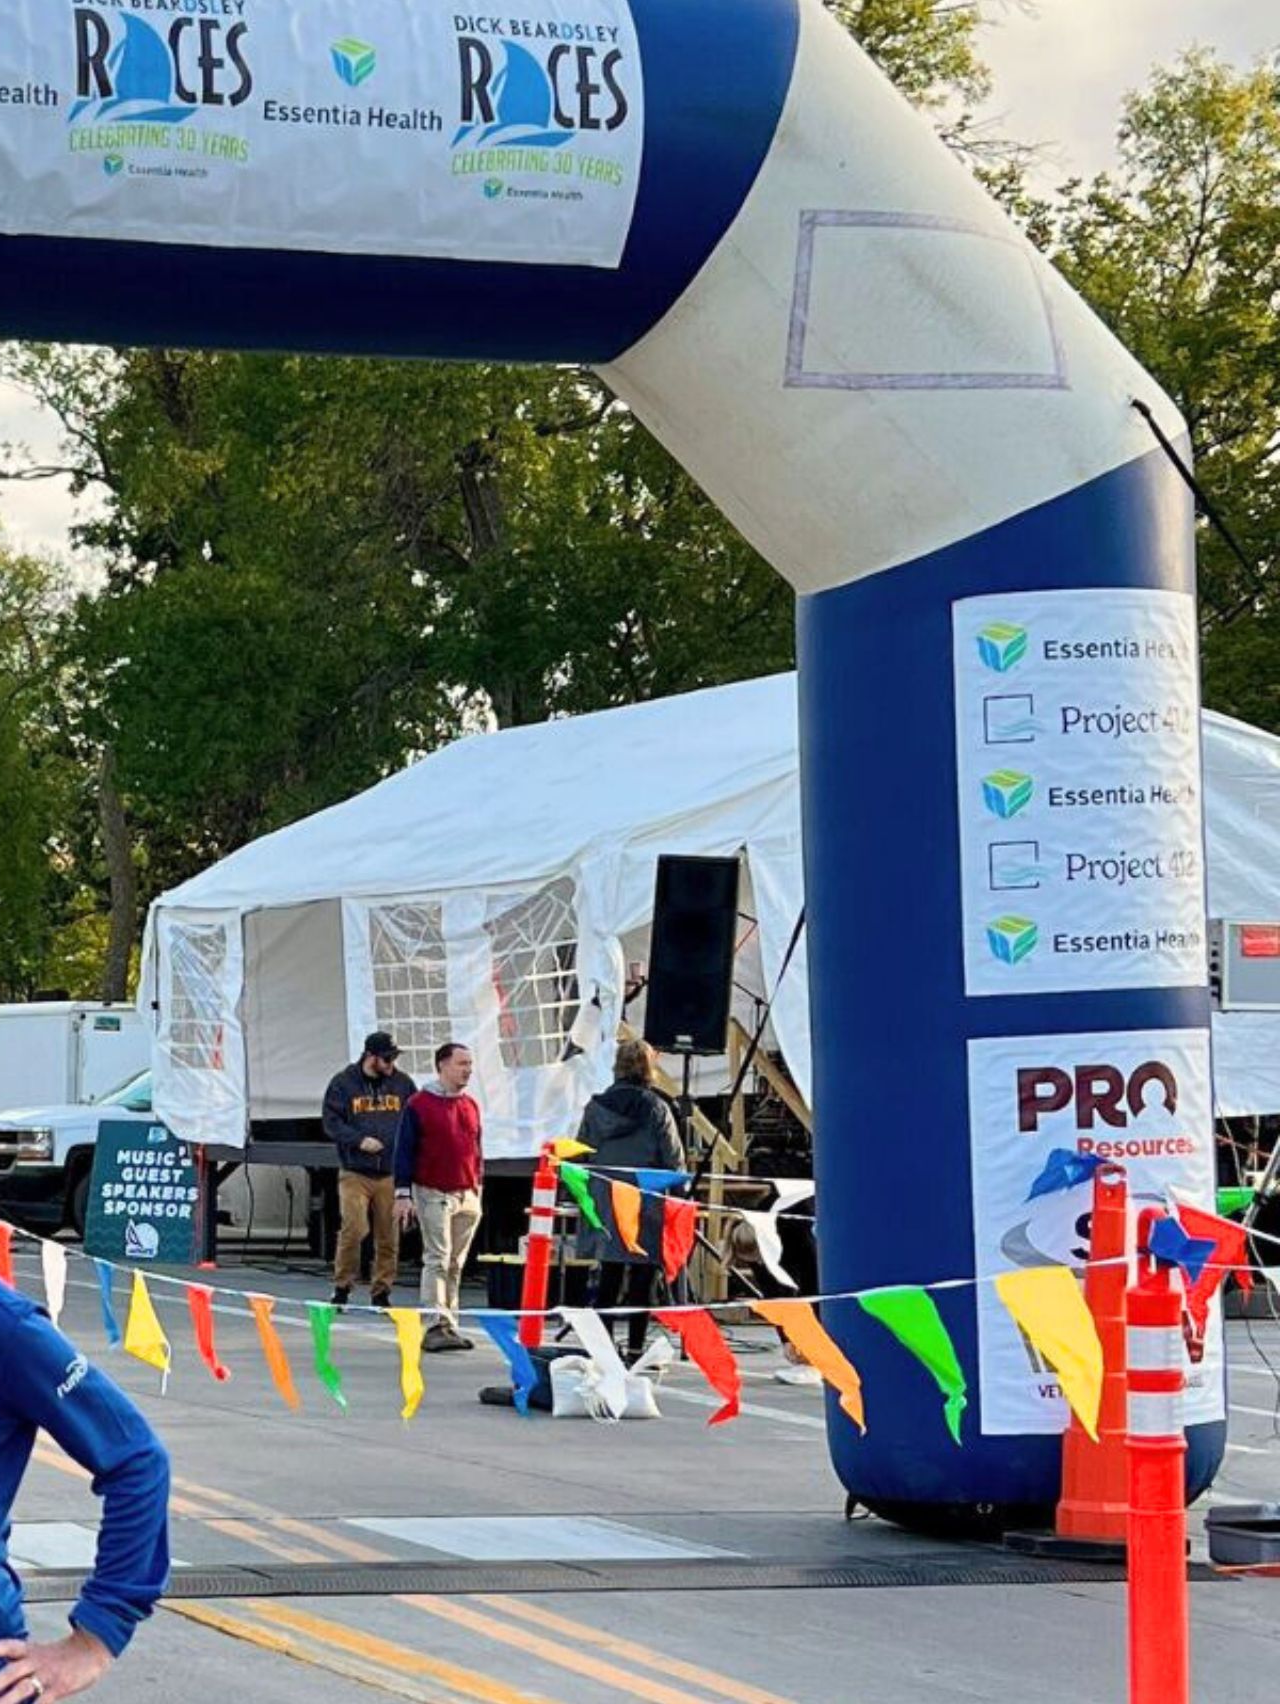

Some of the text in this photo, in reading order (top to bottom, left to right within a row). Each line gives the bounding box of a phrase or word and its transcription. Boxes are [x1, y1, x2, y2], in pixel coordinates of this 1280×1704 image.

[453, 15, 620, 43] DICK BEARDSLEY
[263, 100, 443, 132] Essentia Health
[69, 123, 248, 162] CELEBRATING 30 YEARS
[128, 164, 208, 178] Essentia Health
[451, 149, 623, 185] CELEBRATING 30 YEARS
[1044, 638, 1140, 660] Essentia
[1061, 705, 1160, 738] Project
[1049, 784, 1145, 807] Essentia
[1066, 850, 1196, 885] Project 412
[1053, 931, 1150, 953] Essentia
[1017, 1060, 1177, 1132] PRO
[116, 1150, 176, 1166] MUSIC
[1077, 1136, 1194, 1158] Resources
[121, 1167, 184, 1183] GUEST
[101, 1183, 199, 1201] SPEAKERS
[103, 1201, 192, 1218] SPONSOR
